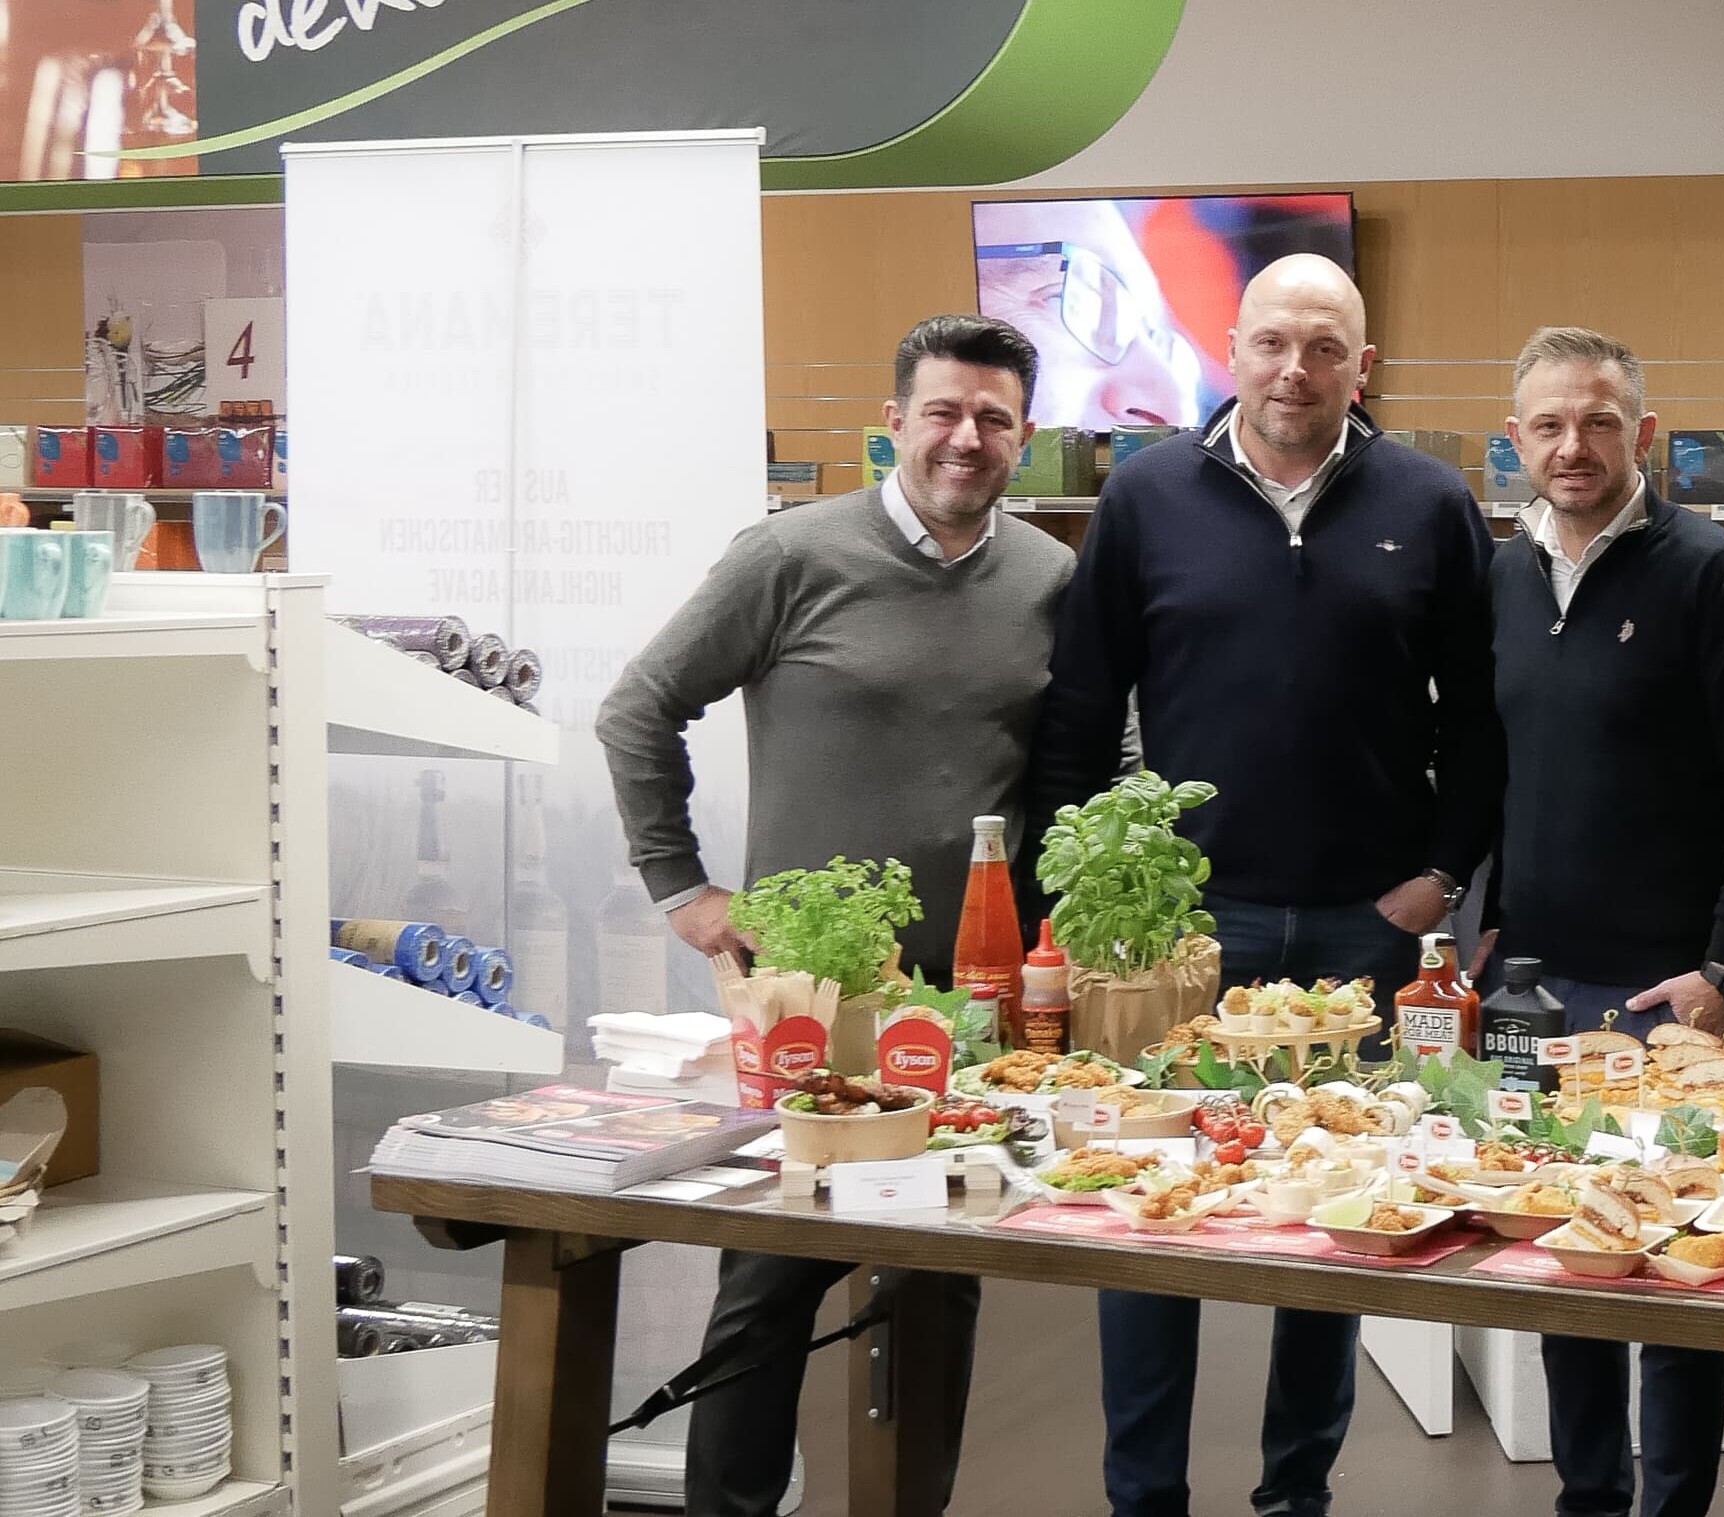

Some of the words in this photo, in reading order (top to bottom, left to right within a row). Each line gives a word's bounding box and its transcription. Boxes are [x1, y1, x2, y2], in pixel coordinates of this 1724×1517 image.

[226, 320, 255, 379] 4
[1403, 1012, 1454, 1031] MADE
[893, 1050, 936, 1070] Tyson
